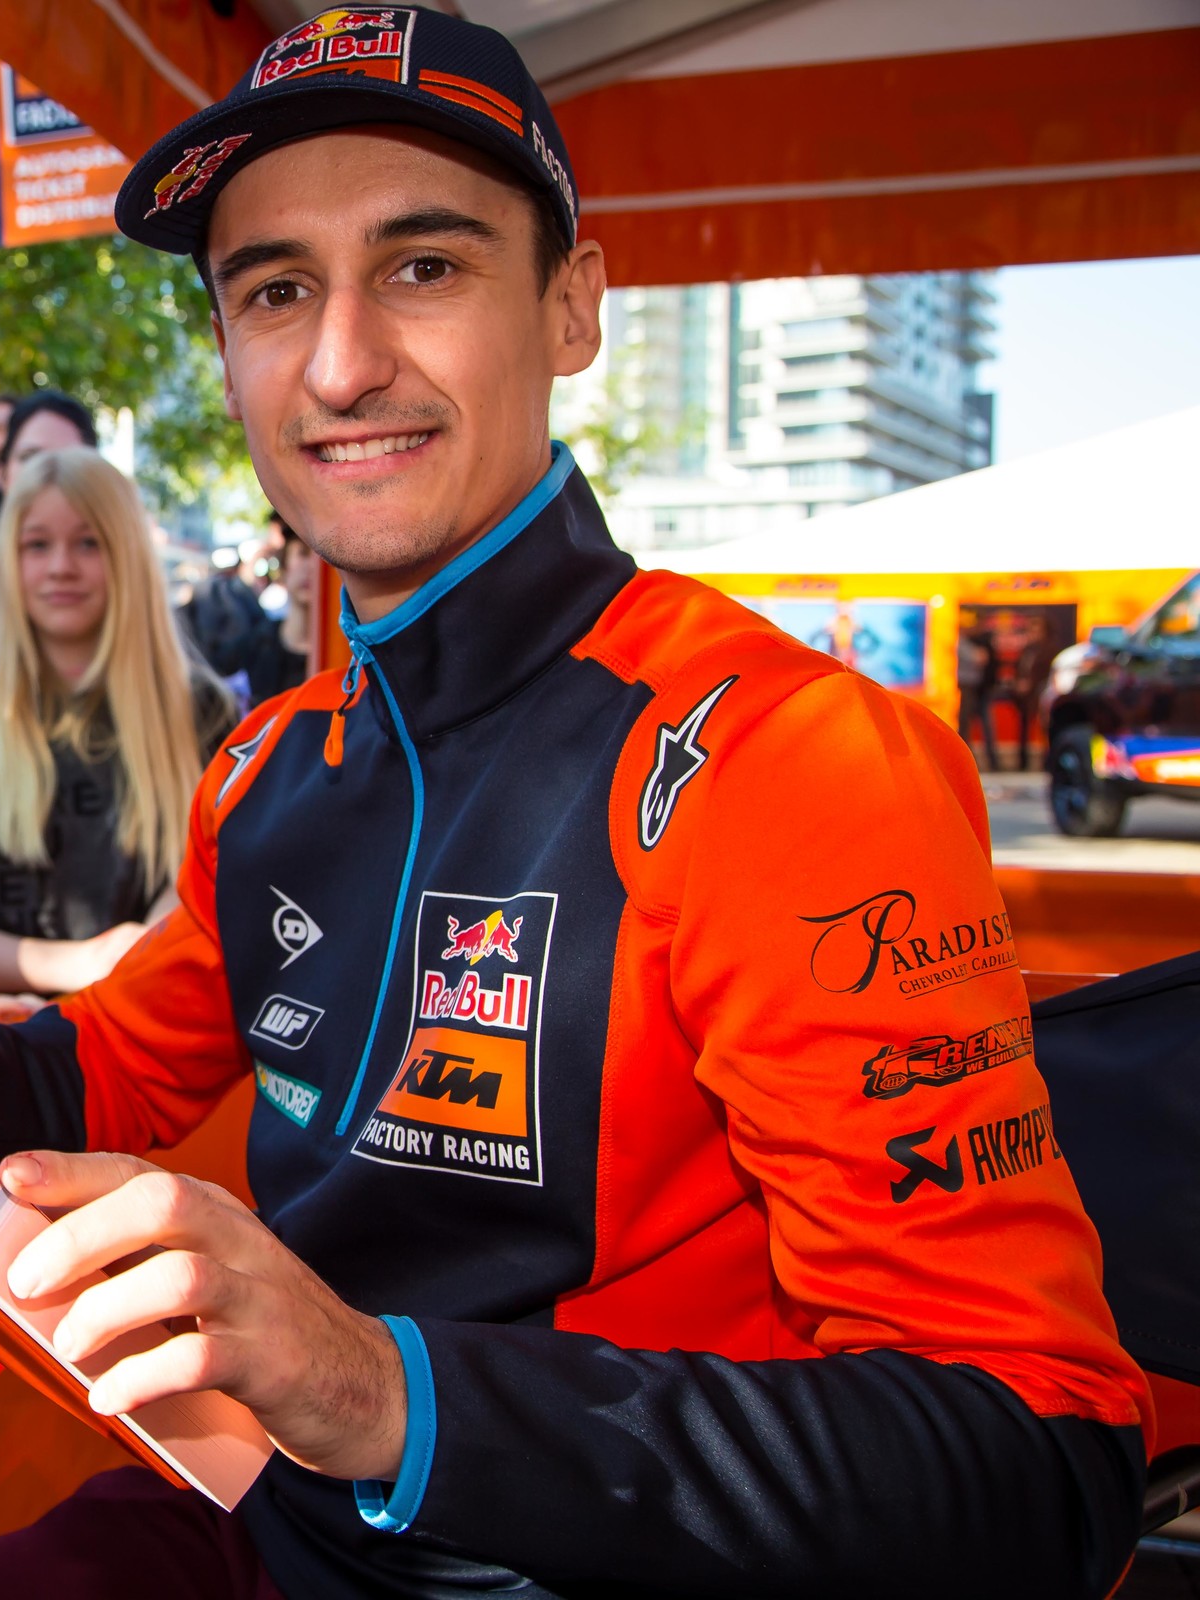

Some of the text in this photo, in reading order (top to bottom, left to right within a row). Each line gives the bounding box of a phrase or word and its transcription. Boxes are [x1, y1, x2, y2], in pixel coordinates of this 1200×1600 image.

[256, 31, 402, 88] Red Bull
[453, 970, 532, 1031] Bull
[396, 1049, 503, 1110] KTM
[966, 1061, 985, 1074] WE
[264, 1069, 318, 1123] MOTOREX
[360, 1117, 531, 1171] FACTORY RACING
